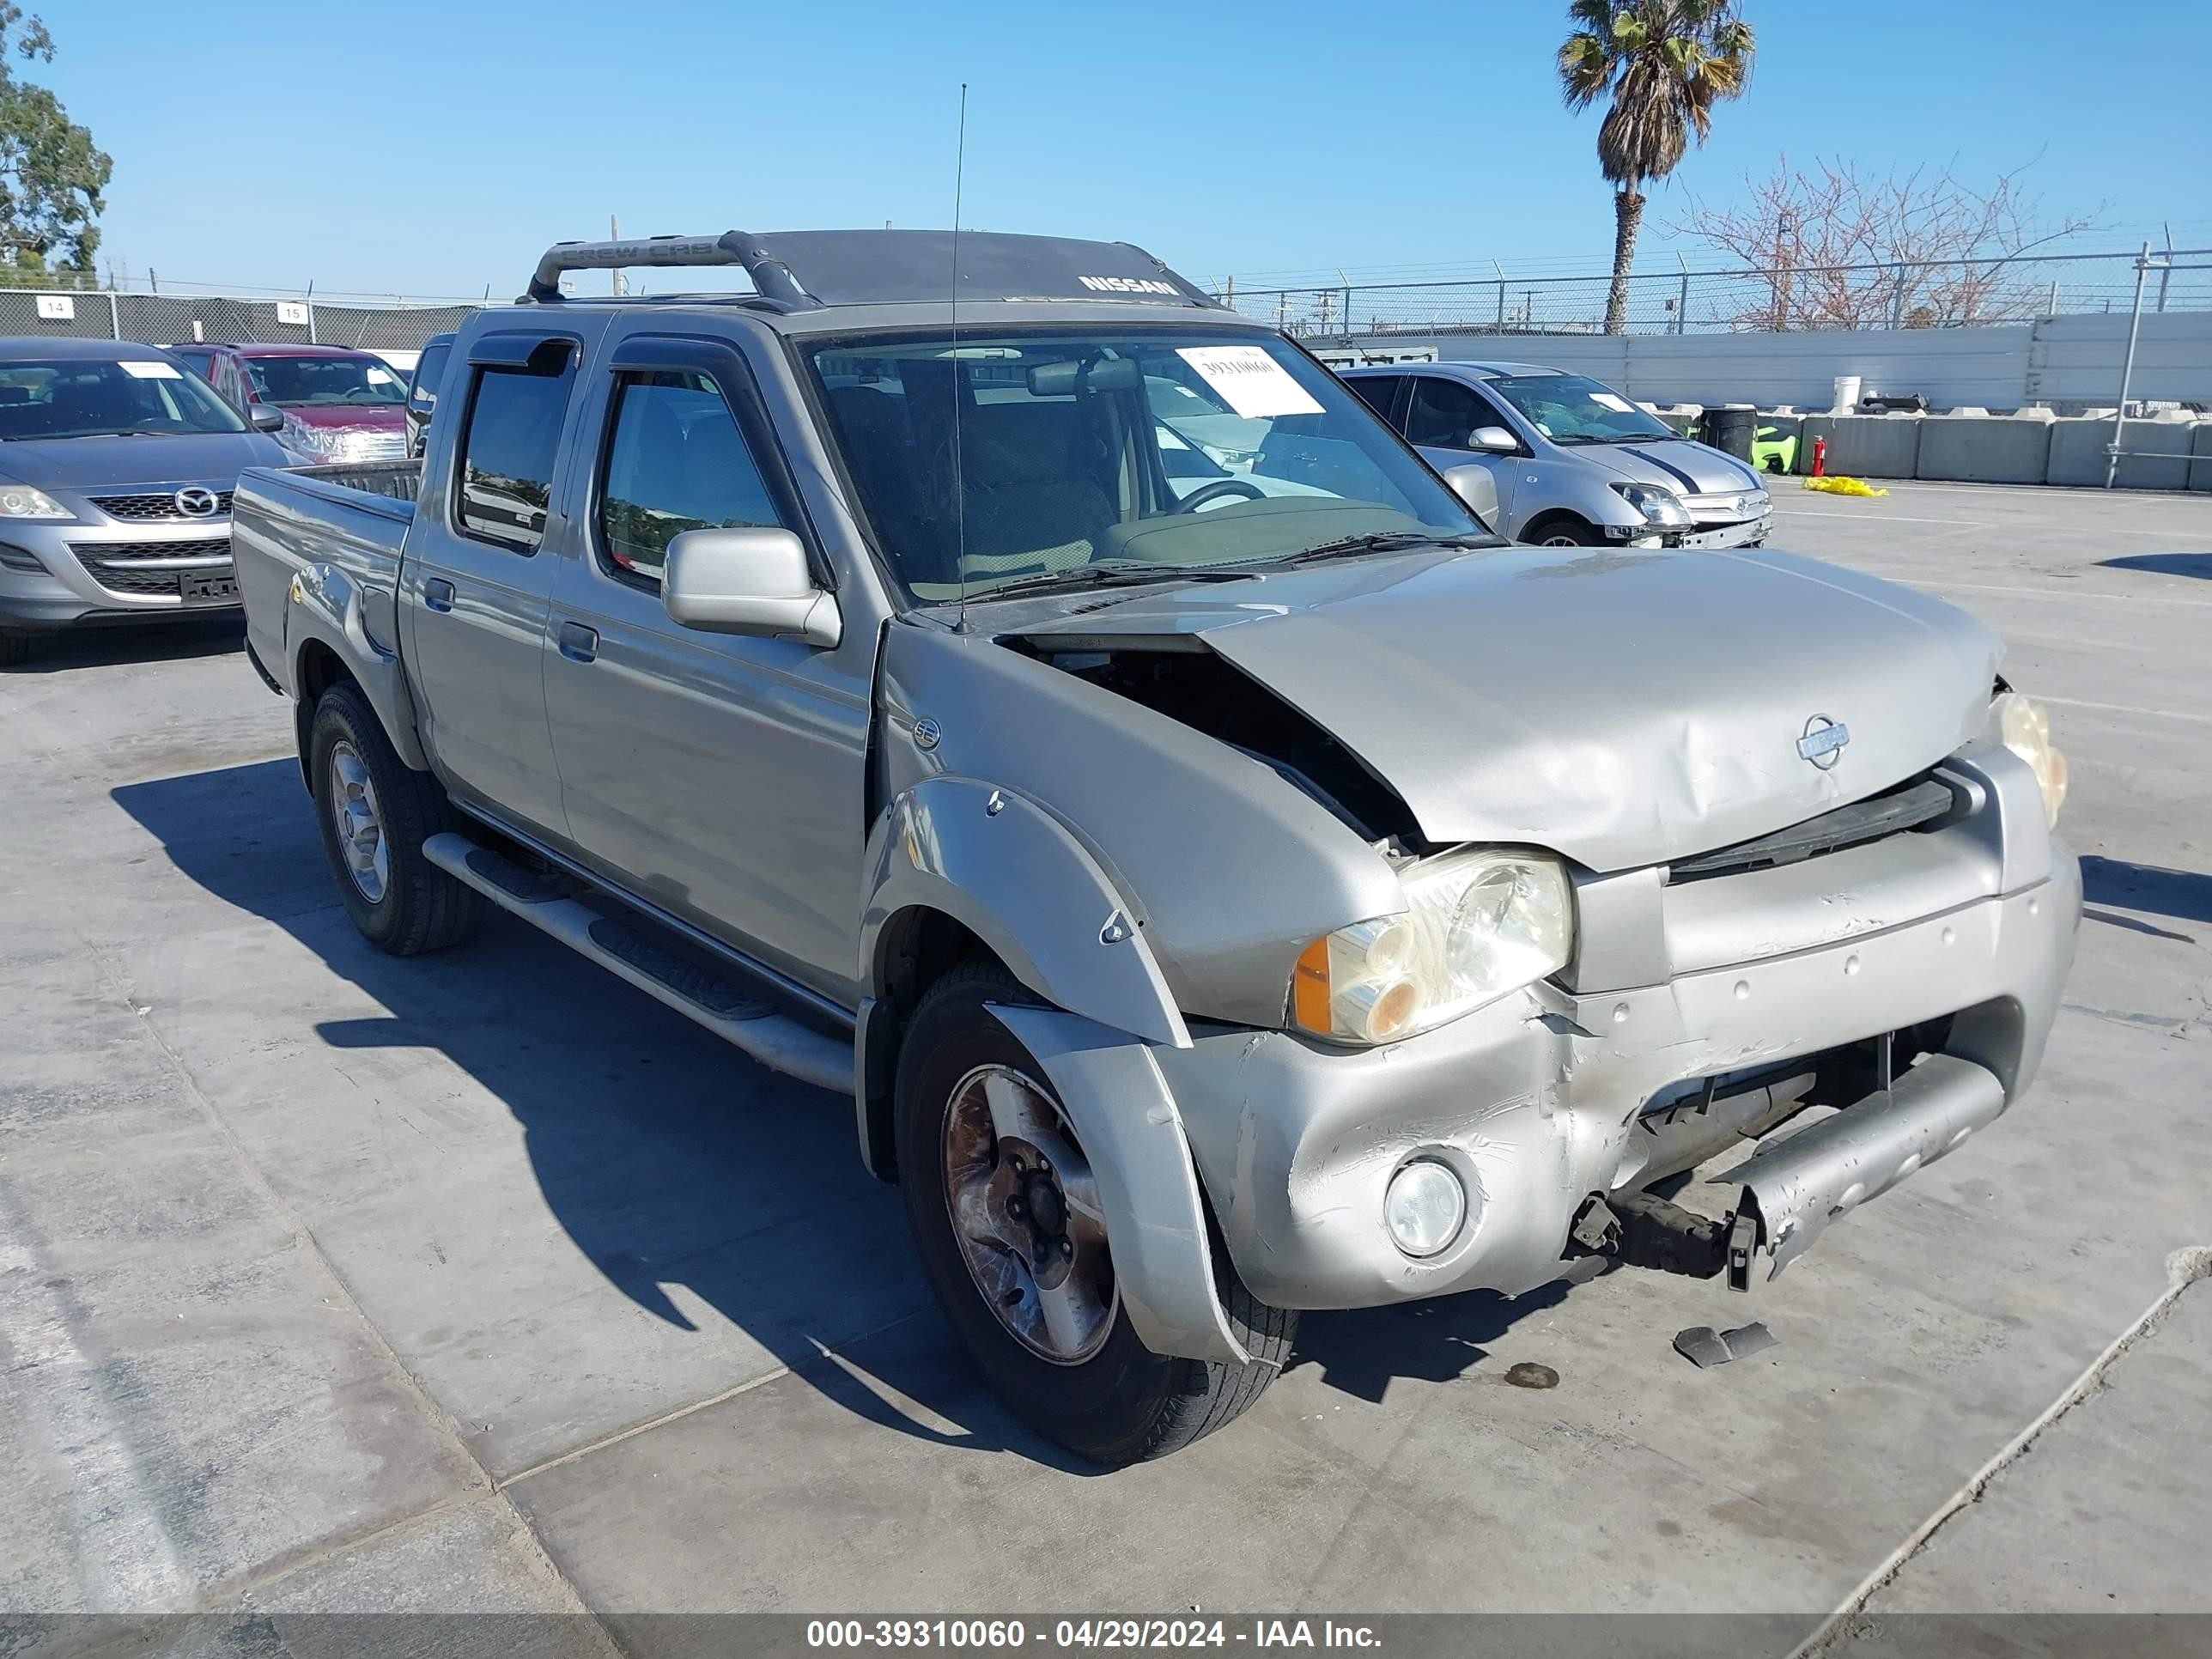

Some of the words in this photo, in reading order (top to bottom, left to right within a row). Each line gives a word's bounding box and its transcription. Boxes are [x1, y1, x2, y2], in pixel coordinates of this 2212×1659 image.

[562, 246, 639, 261] CREW
[649, 243, 713, 257] CAB
[1079, 276, 1181, 296] NISSAN
[48, 302, 64, 313] 14
[287, 308, 301, 319] 15
[1201, 361, 1275, 376] 39310060
[915, 723, 936, 743] SE
